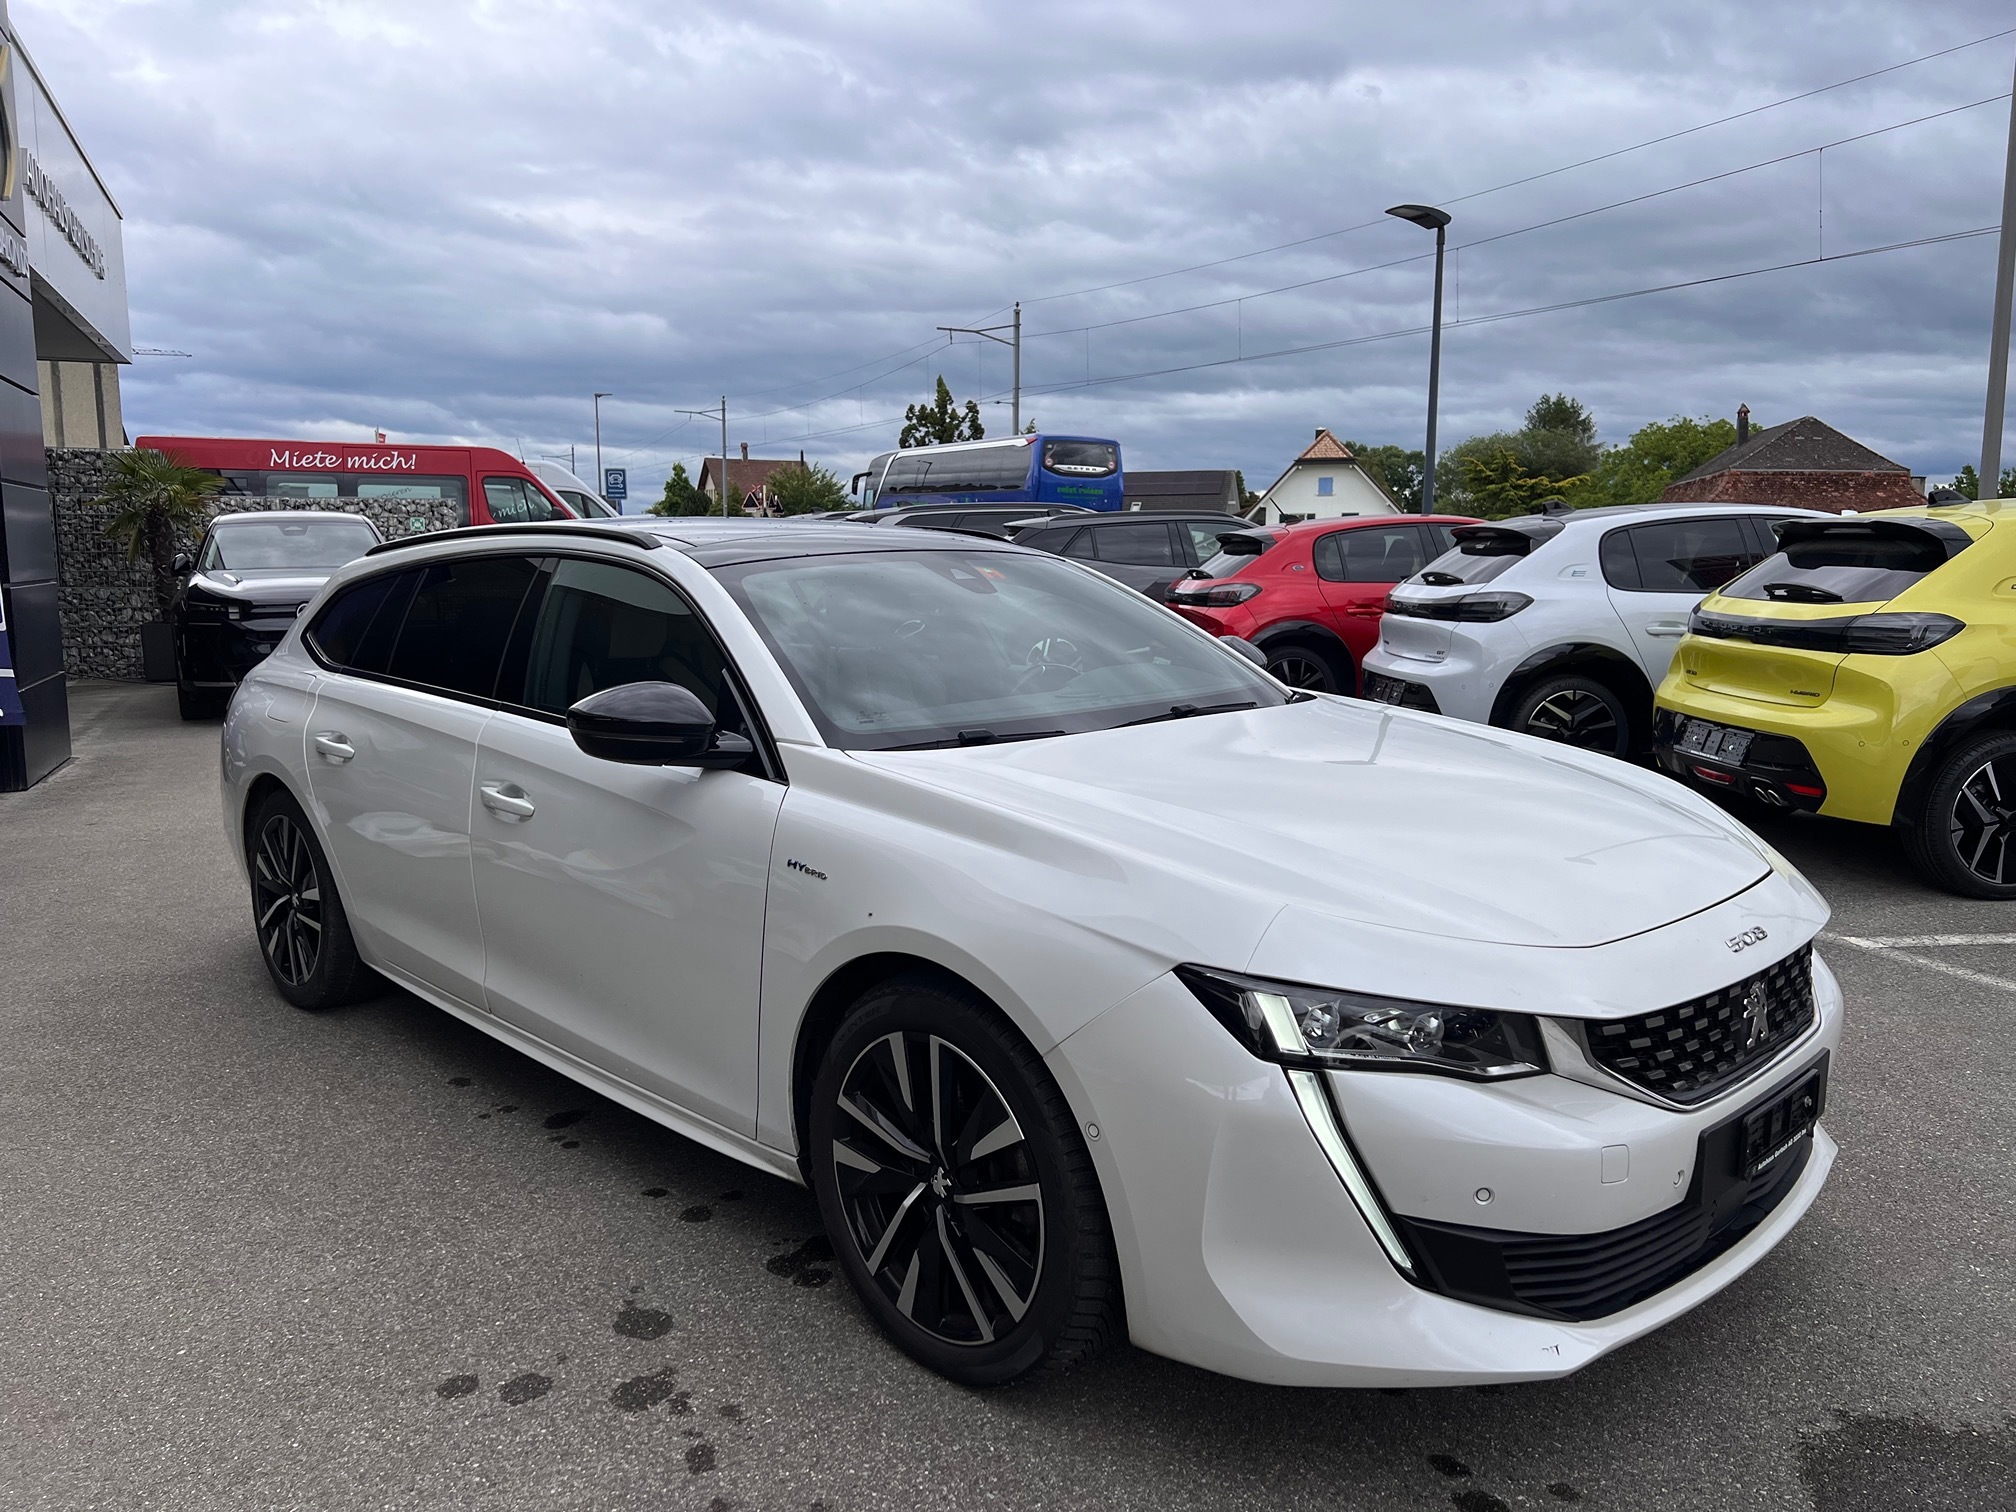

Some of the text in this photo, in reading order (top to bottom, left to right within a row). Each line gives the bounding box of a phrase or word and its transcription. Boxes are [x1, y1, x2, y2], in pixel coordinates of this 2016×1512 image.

[270, 448, 417, 470] Miete mich!
[786, 858, 828, 880] HYBRID
[1724, 926, 1768, 953] 508
